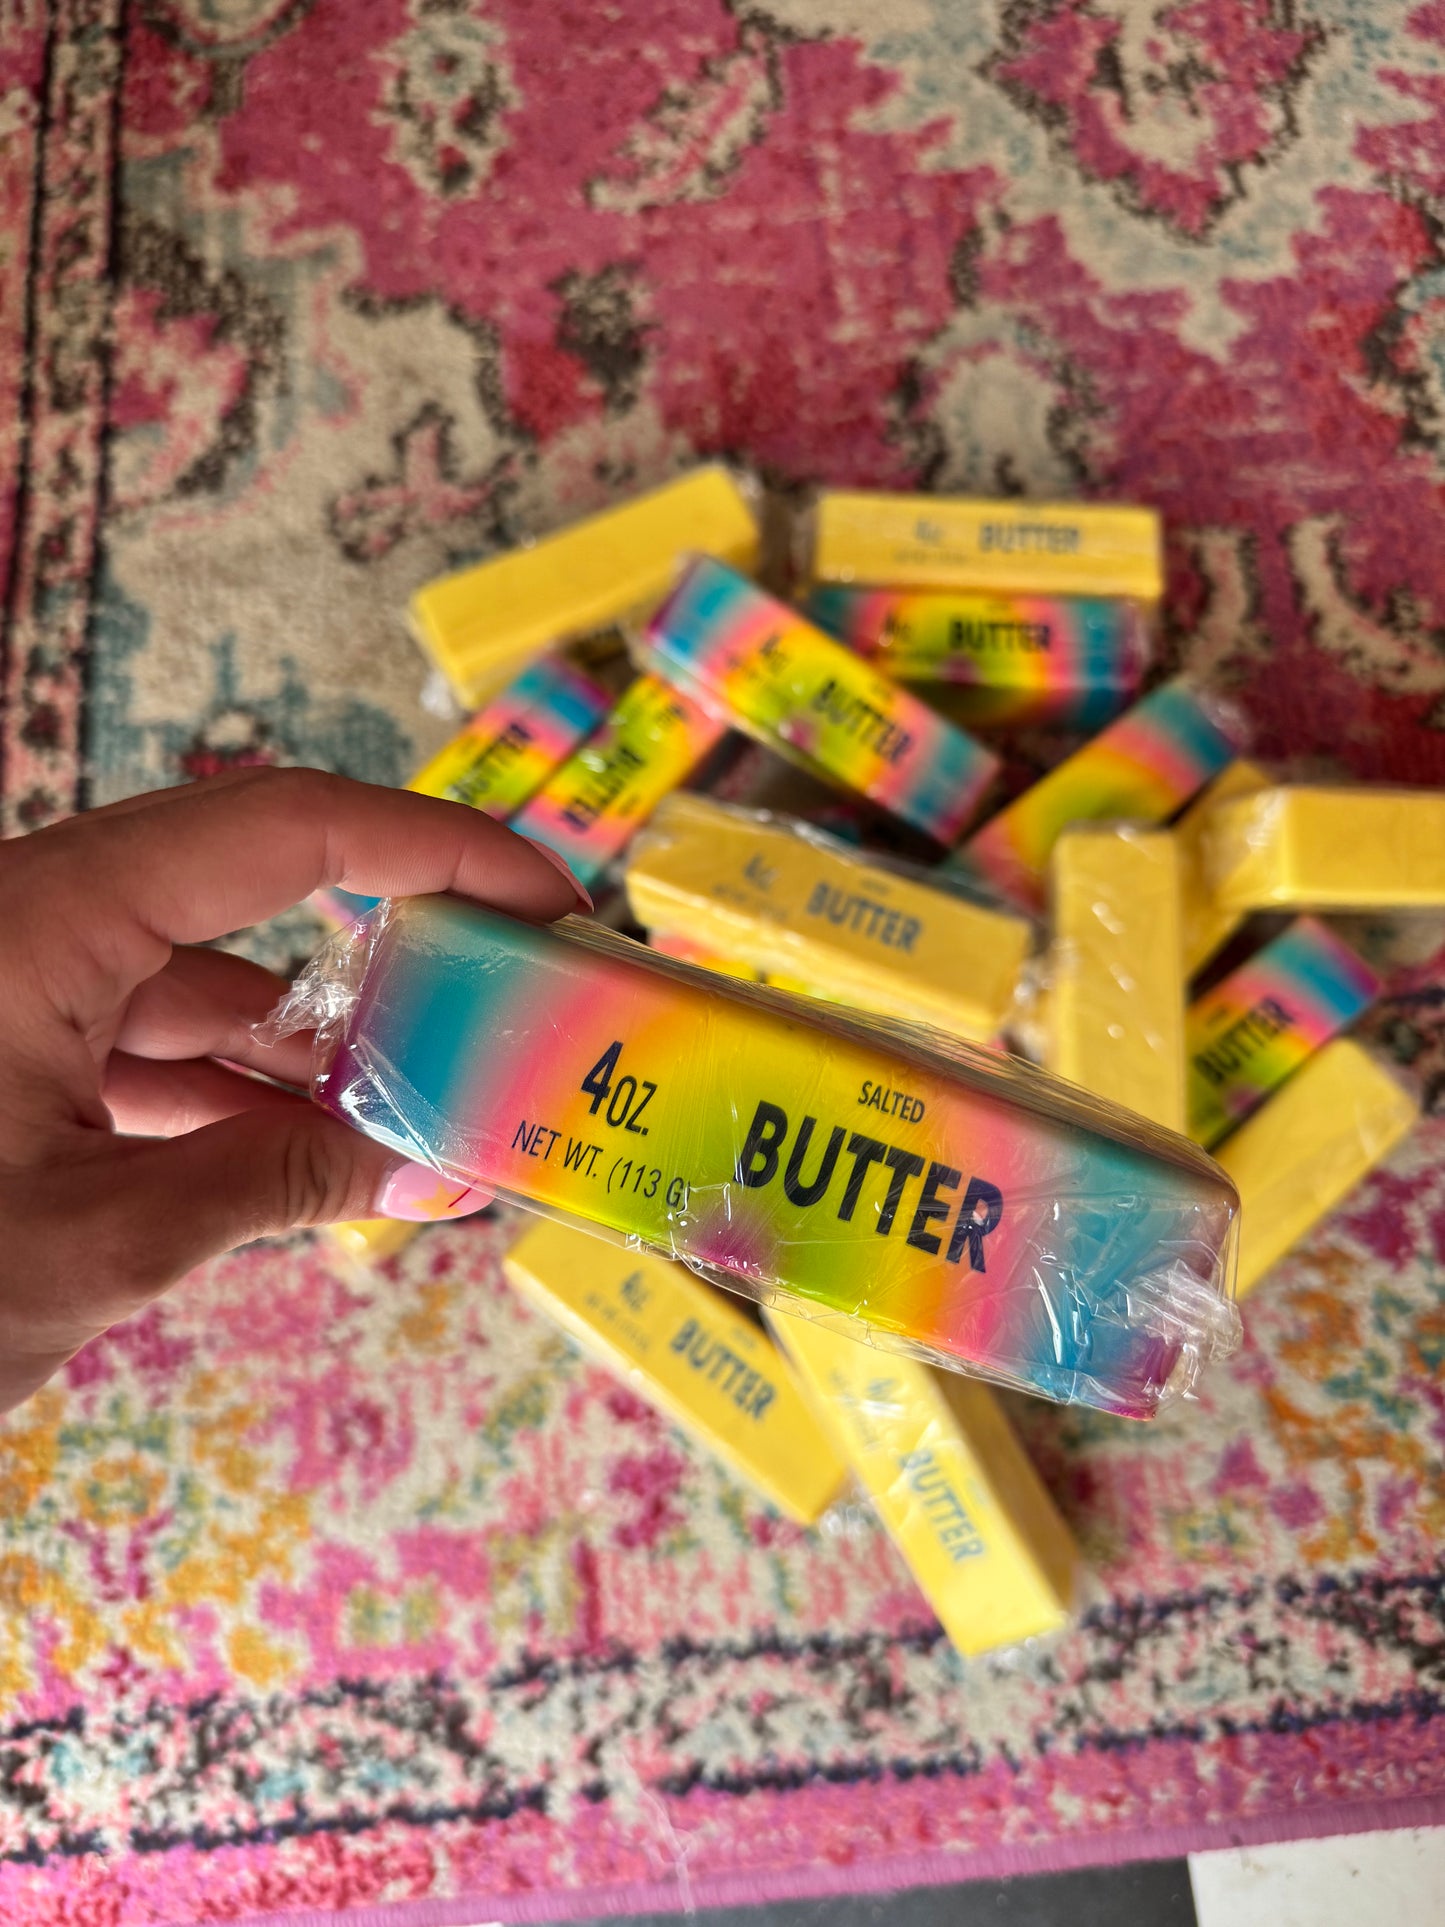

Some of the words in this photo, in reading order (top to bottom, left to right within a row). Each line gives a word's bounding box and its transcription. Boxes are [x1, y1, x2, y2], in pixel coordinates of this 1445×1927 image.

[978, 521, 1081, 555] BUTTER
[951, 618, 1051, 651] BUTTER
[810, 679, 913, 763] BUTTER
[805, 881, 924, 953] BUTTER
[1193, 996, 1295, 1087] BUTTER
[857, 1080, 926, 1124] SALTED
[511, 1119, 562, 1161] NET
[563, 1137, 604, 1179] WT.
[606, 1156, 662, 1199] (113
[732, 1100, 1004, 1274] BUTTER
[670, 1318, 777, 1422] BUTTER
[898, 1449, 986, 1562] BUTTER
